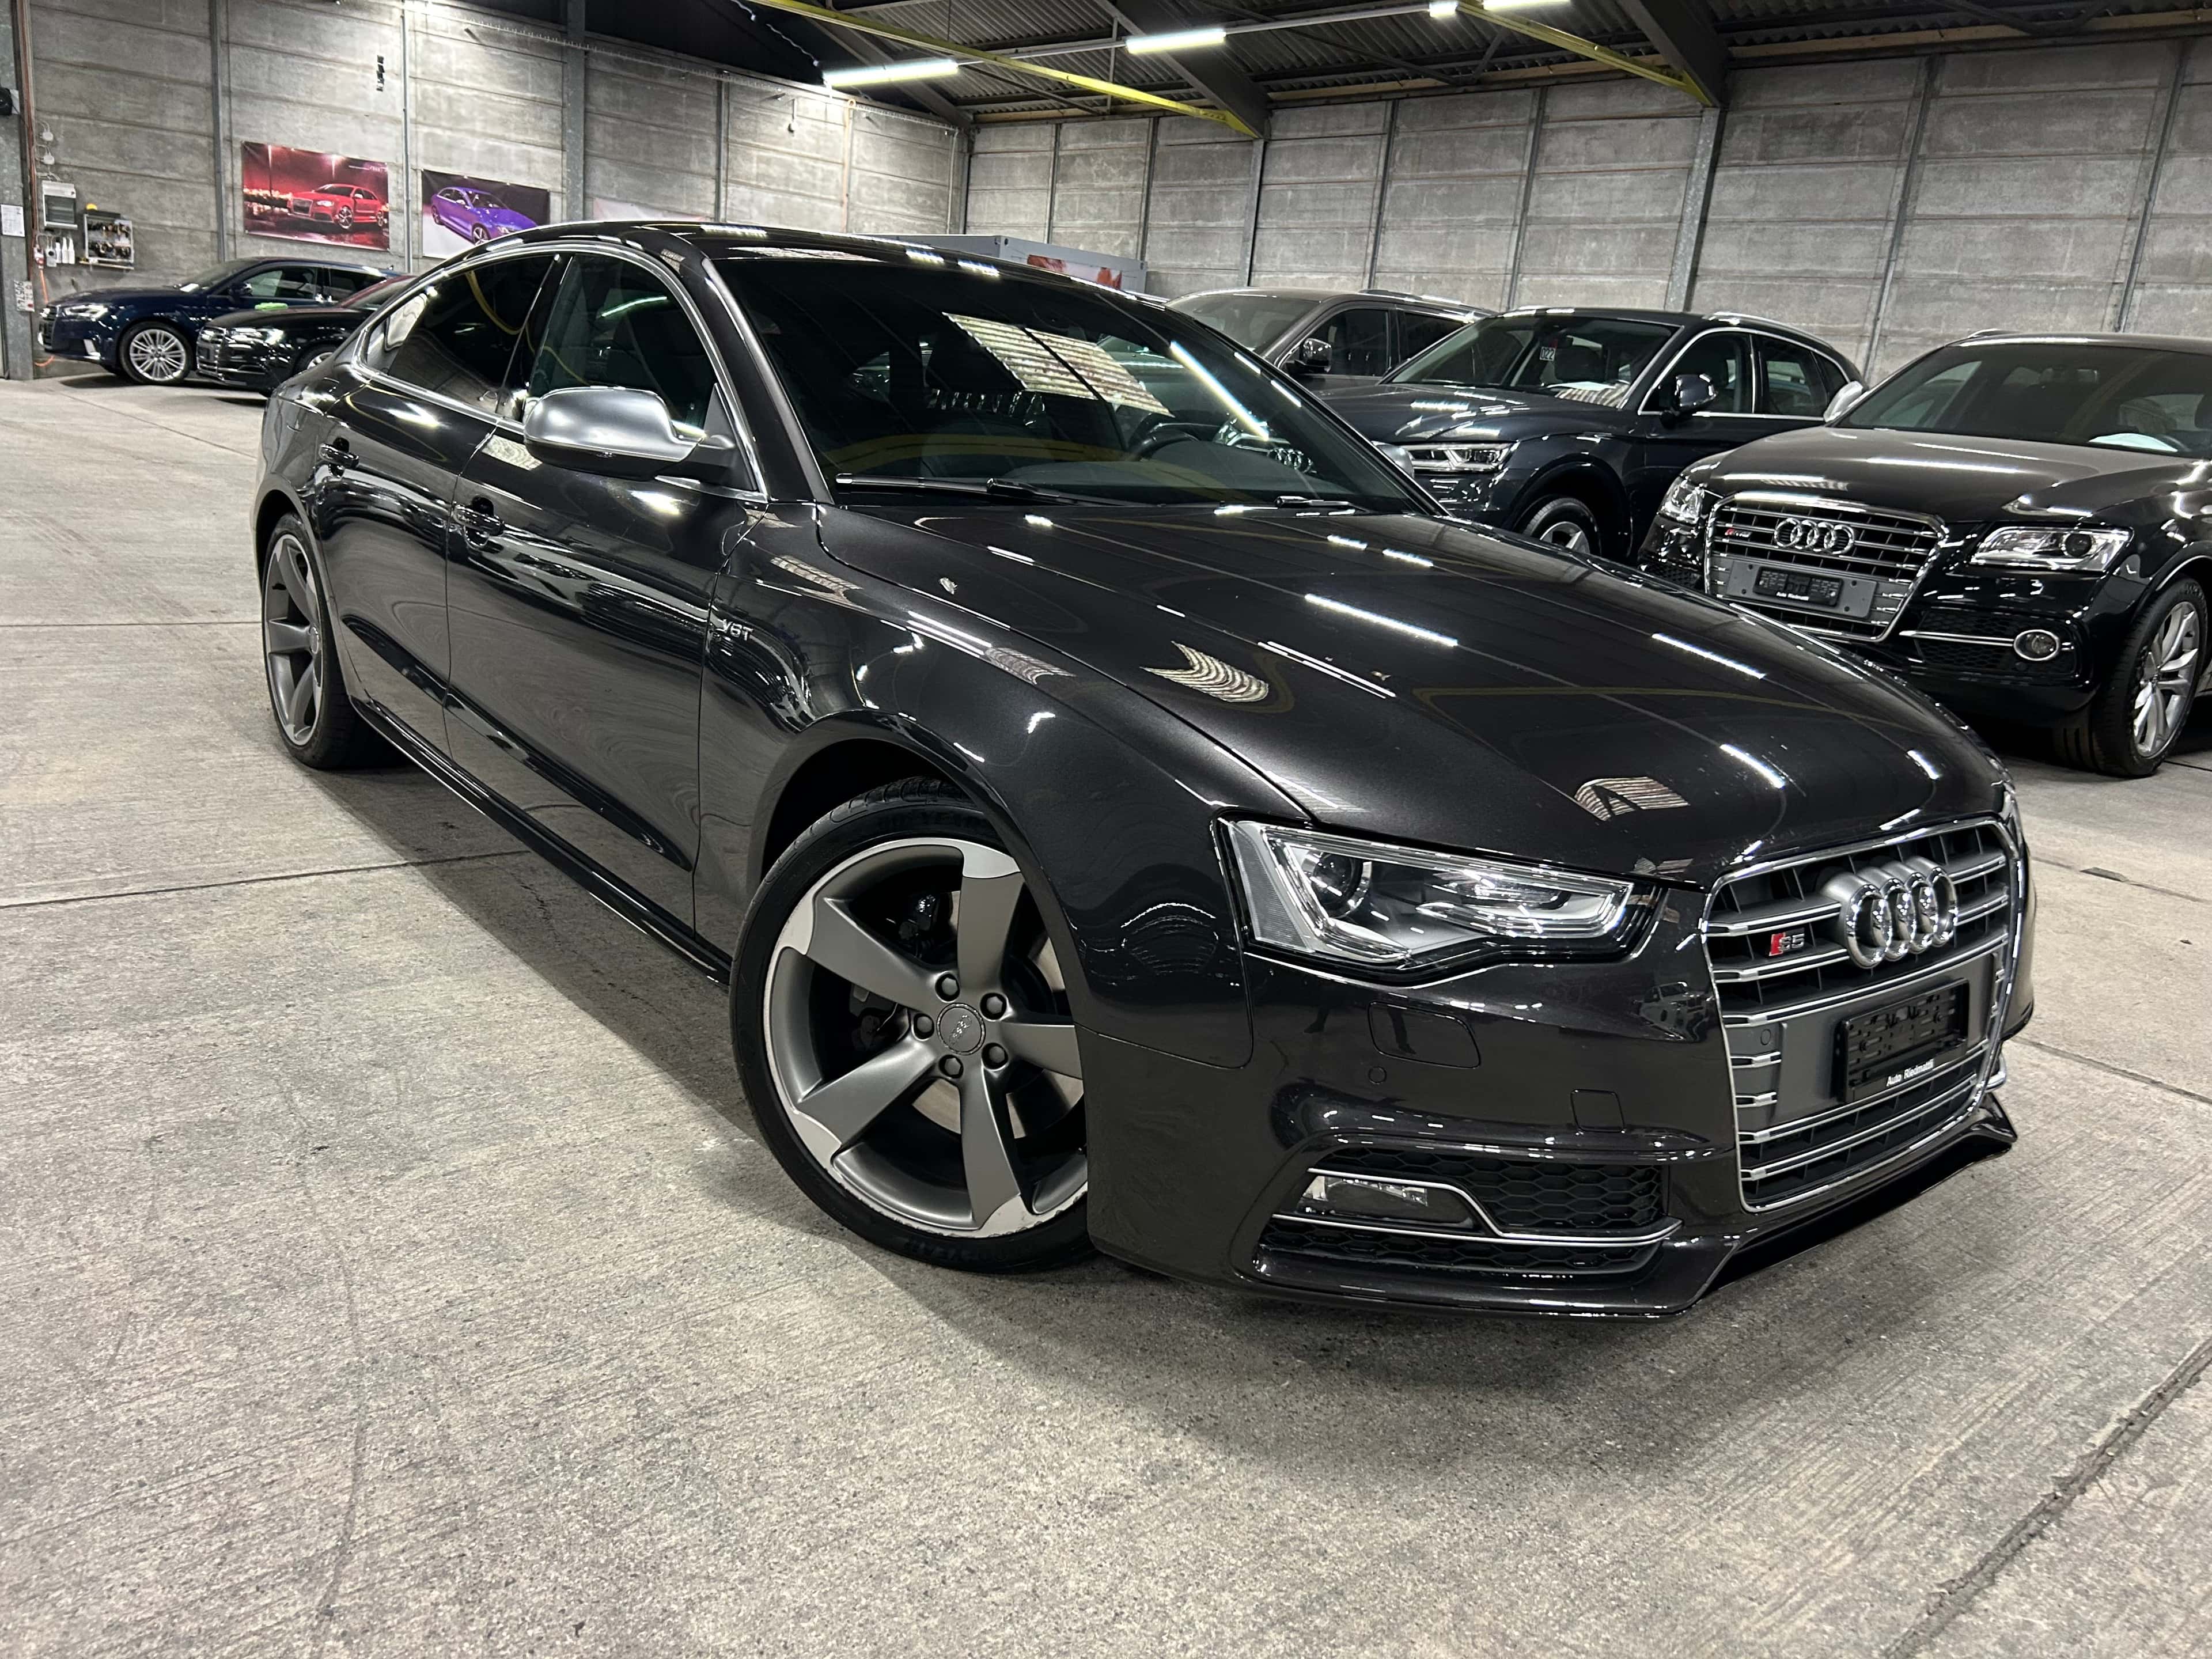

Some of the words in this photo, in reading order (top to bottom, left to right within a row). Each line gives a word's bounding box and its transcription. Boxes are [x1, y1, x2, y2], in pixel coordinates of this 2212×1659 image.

[723, 619, 753, 641] V6T
[1778, 933, 1805, 952] S5
[1887, 1074, 1902, 1086] Auto
